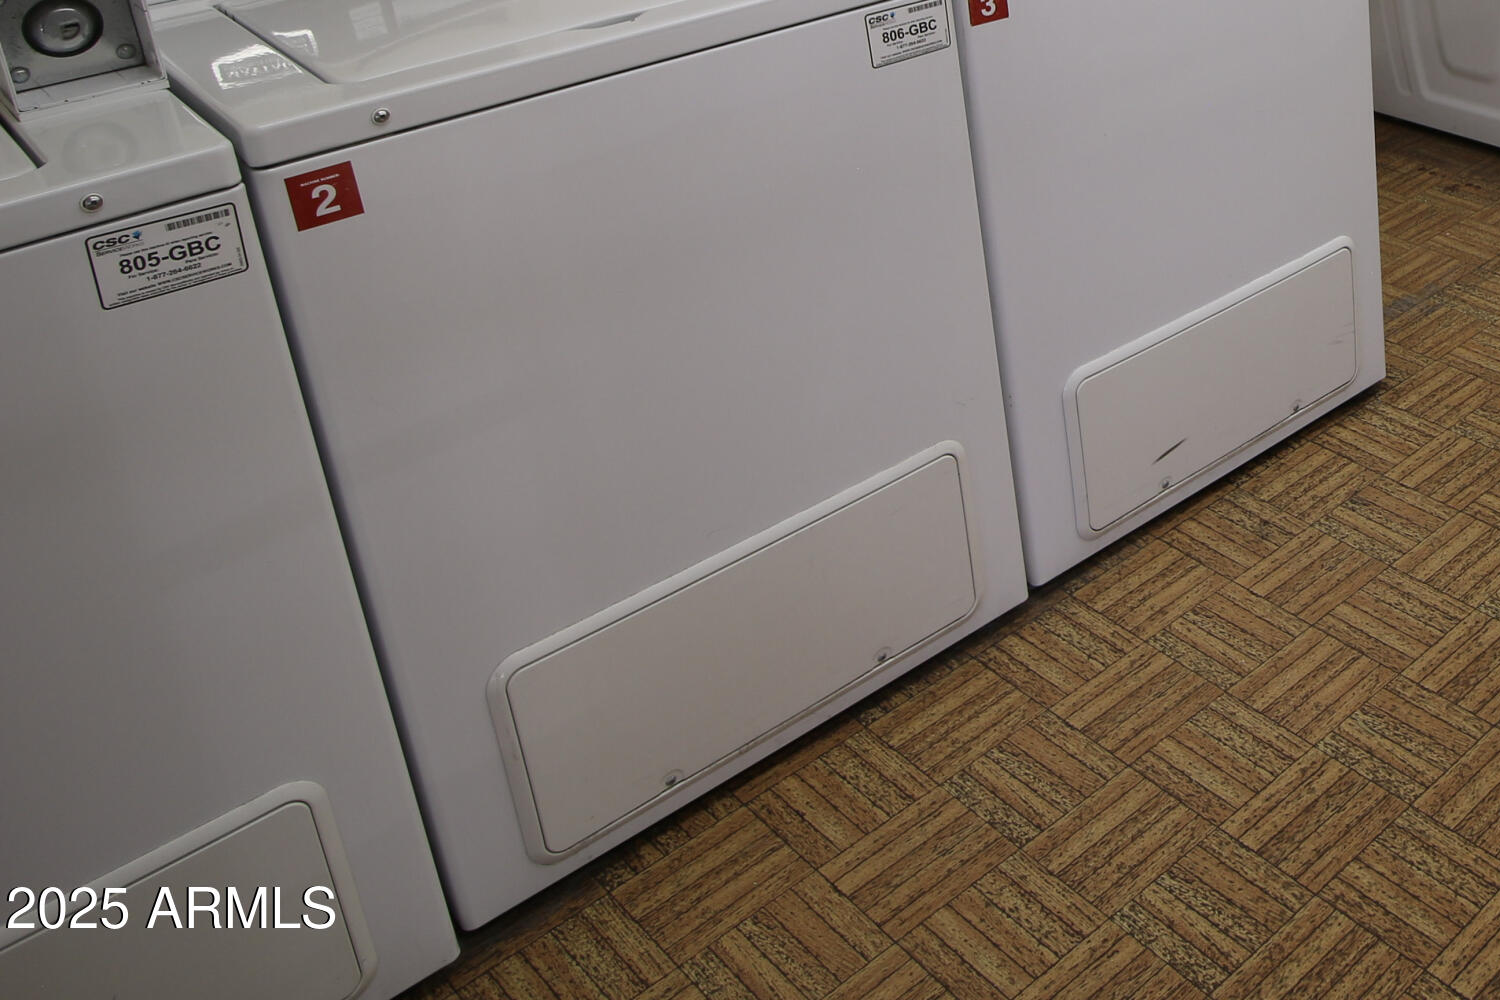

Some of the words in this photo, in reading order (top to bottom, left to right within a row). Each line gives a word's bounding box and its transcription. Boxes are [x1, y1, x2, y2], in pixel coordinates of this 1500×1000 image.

[868, 14, 889, 25] CSC
[882, 19, 937, 44] 806-GBC
[311, 183, 342, 217] 2
[92, 234, 130, 251] CSC
[119, 235, 221, 275] 805-GBC
